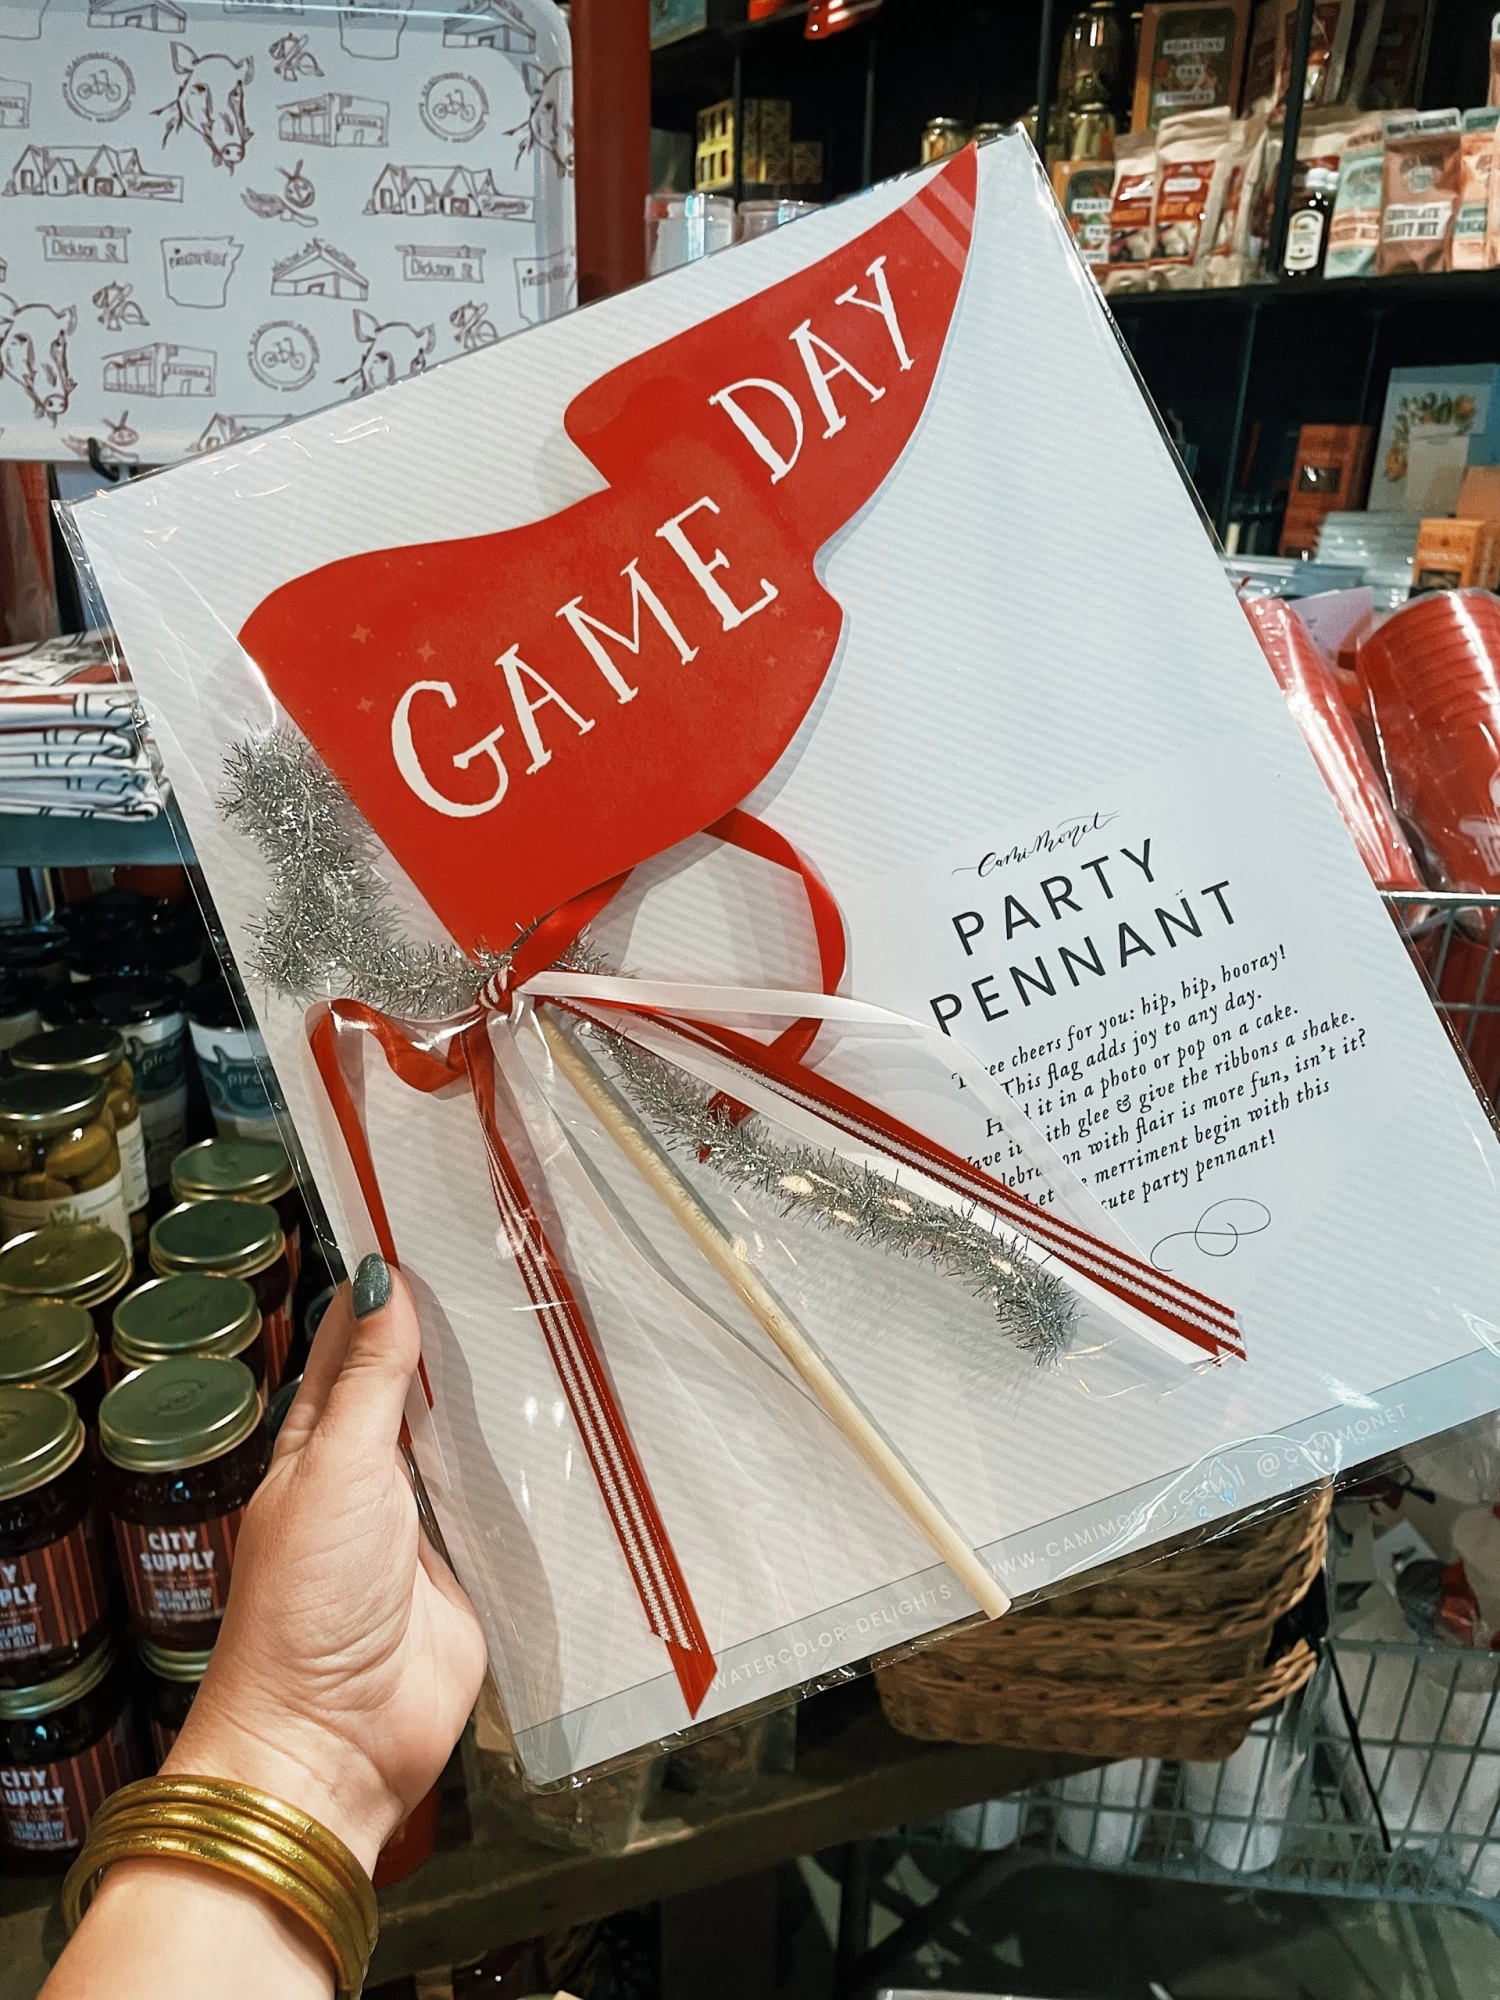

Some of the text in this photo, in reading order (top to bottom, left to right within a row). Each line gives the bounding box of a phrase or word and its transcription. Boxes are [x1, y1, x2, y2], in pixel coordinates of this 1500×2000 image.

[391, 255, 914, 817] GAME DAY
[952, 838, 1157, 956] PARTY
[930, 880, 1237, 1037] PENNANT
[1012, 1038, 1061, 1067] cheers
[1067, 1024, 1093, 1051] for
[1098, 1008, 1135, 1040] you:
[1141, 993, 1176, 1016] hip,
[1181, 977, 1216, 999] hip,
[1220, 944, 1286, 983] hooray!
[1000, 989, 1262, 1098] This flag adds joy to any day.
[1038, 1099, 1053, 1116] it
[1060, 1089, 1077, 1107] in
[1084, 1085, 1094, 1098] a
[1100, 1063, 1147, 1099] photo
[1153, 1053, 1170, 1069] or
[1177, 1039, 1205, 1068] pop
[1212, 1030, 1232, 1046] on
[1239, 1023, 1249, 1035] a
[1255, 1004, 1299, 1029] cake.
[1045, 1118, 1071, 1142] ith
[1078, 1107, 1110, 1138] glee
[1117, 1094, 1131, 1113] &
[1139, 1082, 1175, 1113] give
[1182, 1067, 1208, 1089] the
[1214, 1039, 1278, 1074] ribbons
[1285, 1034, 1295, 1047] a
[1302, 1012, 1355, 1041] shake.
[1088, 1124, 1129, 1155] with
[1136, 1109, 1175, 1143] flair
[1182, 1101, 1196, 1119] is
[1203, 1084, 1245, 1110] more
[1251, 1070, 1289, 1097] fun,
[1294, 1045, 1336, 1073] isn't
[1343, 1028, 1366, 1055] it?
[1095, 1135, 1189, 1184] merriment
[1194, 1115, 1241, 1144] begin
[1248, 1091, 1289, 1122] with
[1297, 1078, 1330, 1103] this
[1142, 1167, 1188, 1203] party
[1196, 1129, 1275, 1182] pennant!
[140, 1549, 215, 1571] SUPPLY
[148, 1530, 197, 1551] CITY
[710, 1584, 952, 1692] WATERCOLOR DELIGHTS
[0, 1769, 47, 1789] CITY
